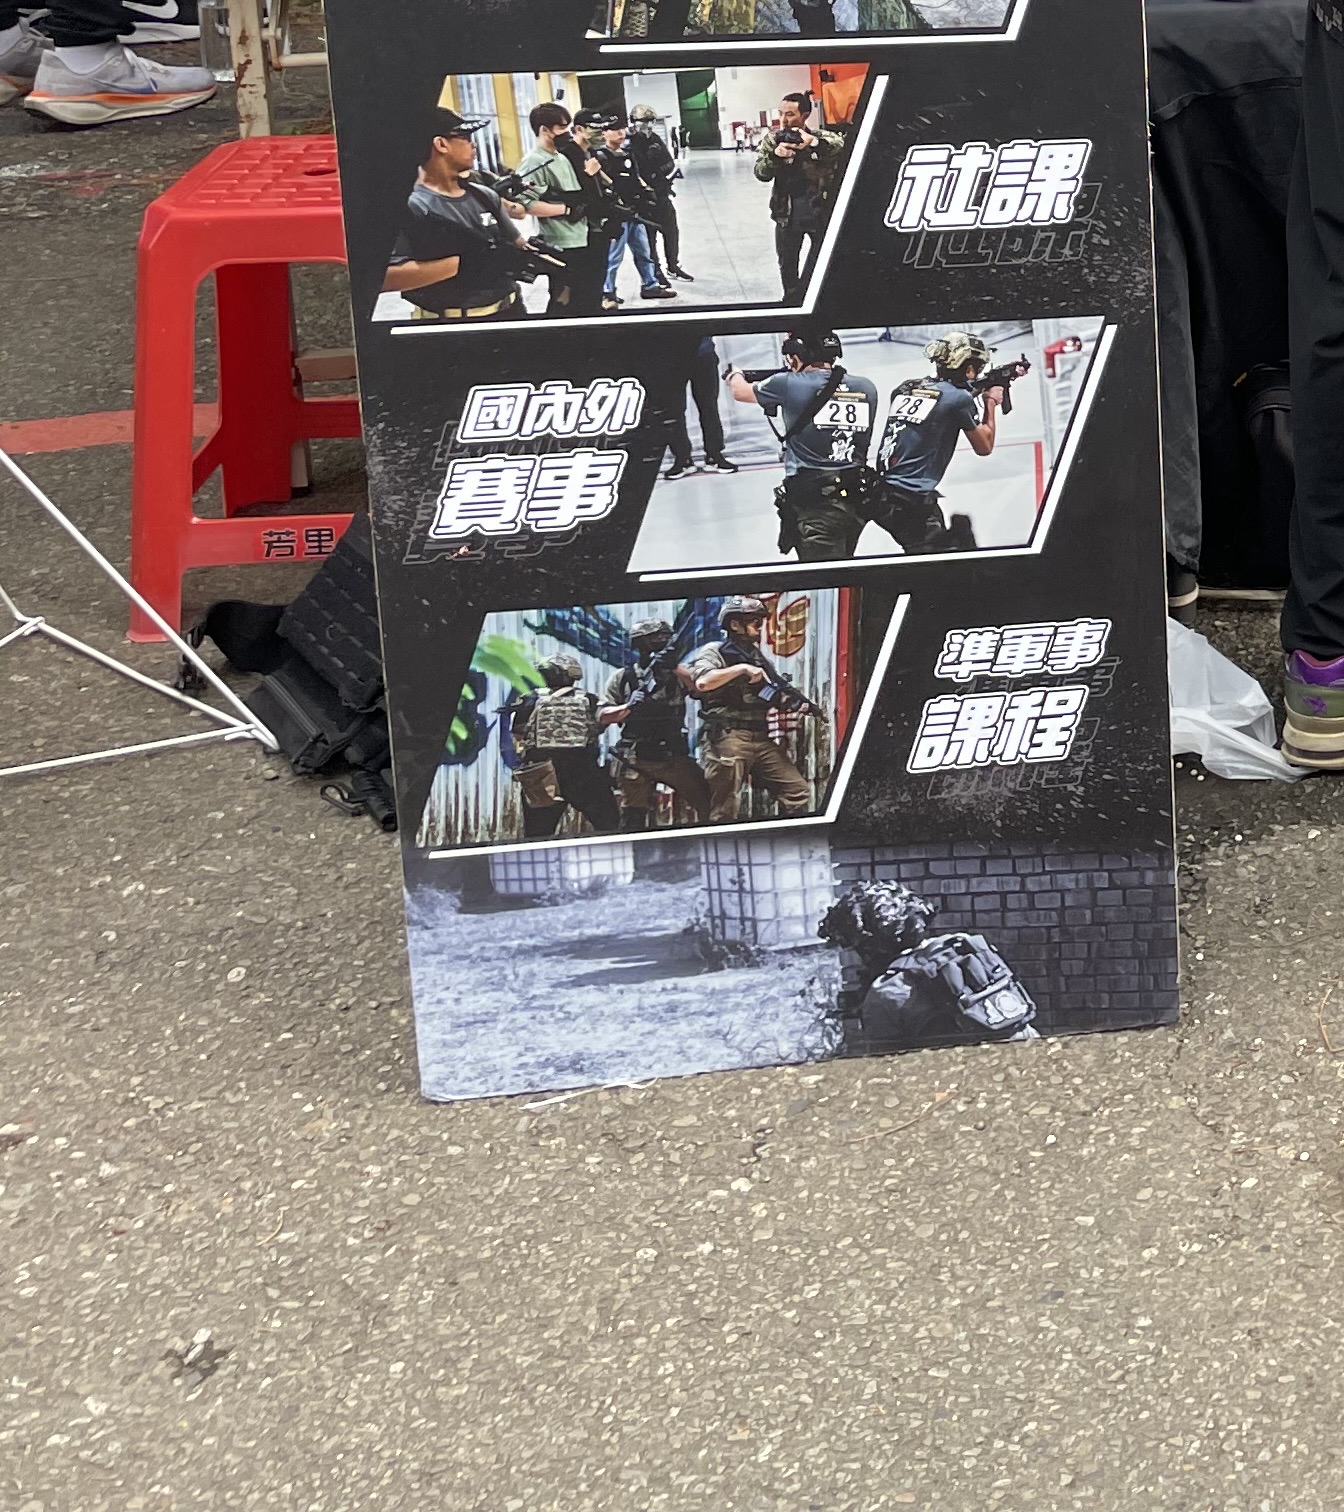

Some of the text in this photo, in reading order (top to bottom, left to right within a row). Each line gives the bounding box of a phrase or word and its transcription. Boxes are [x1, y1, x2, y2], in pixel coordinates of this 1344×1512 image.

[885, 139, 1094, 233] 社課
[456, 379, 645, 445] 國內外
[829, 403, 857, 424] 28
[895, 397, 922, 415] 28
[430, 449, 630, 539] 賽事
[262, 527, 335, 558] 芳里
[933, 620, 1112, 680] 準軍事
[906, 686, 1092, 775] 課程
